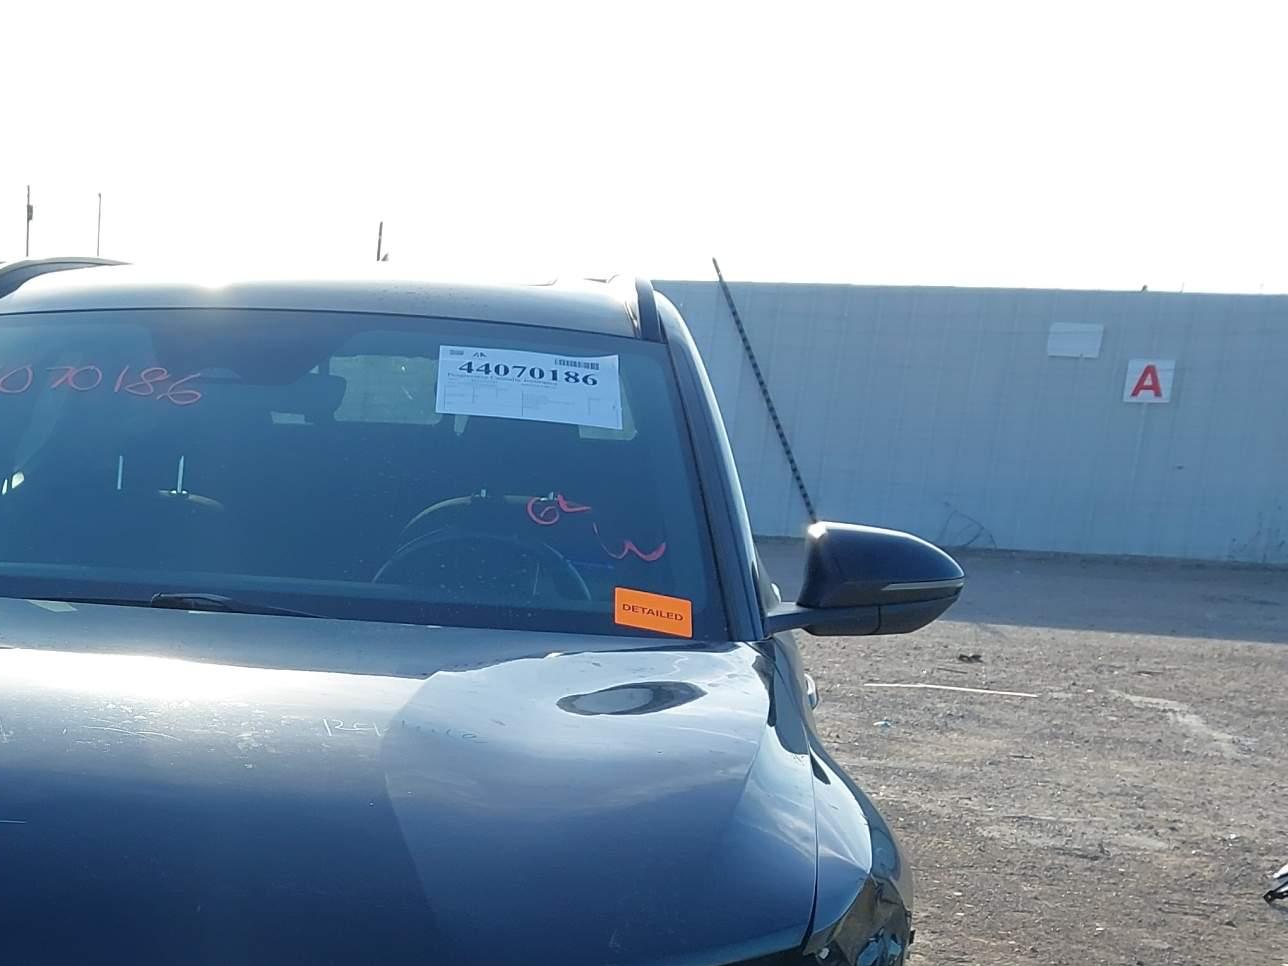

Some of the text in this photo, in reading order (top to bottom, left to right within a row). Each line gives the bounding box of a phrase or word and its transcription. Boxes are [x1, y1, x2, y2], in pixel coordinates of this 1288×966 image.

[458, 360, 599, 387] 44070186
[1130, 364, 1162, 398] A
[621, 603, 684, 622] DETAILED
